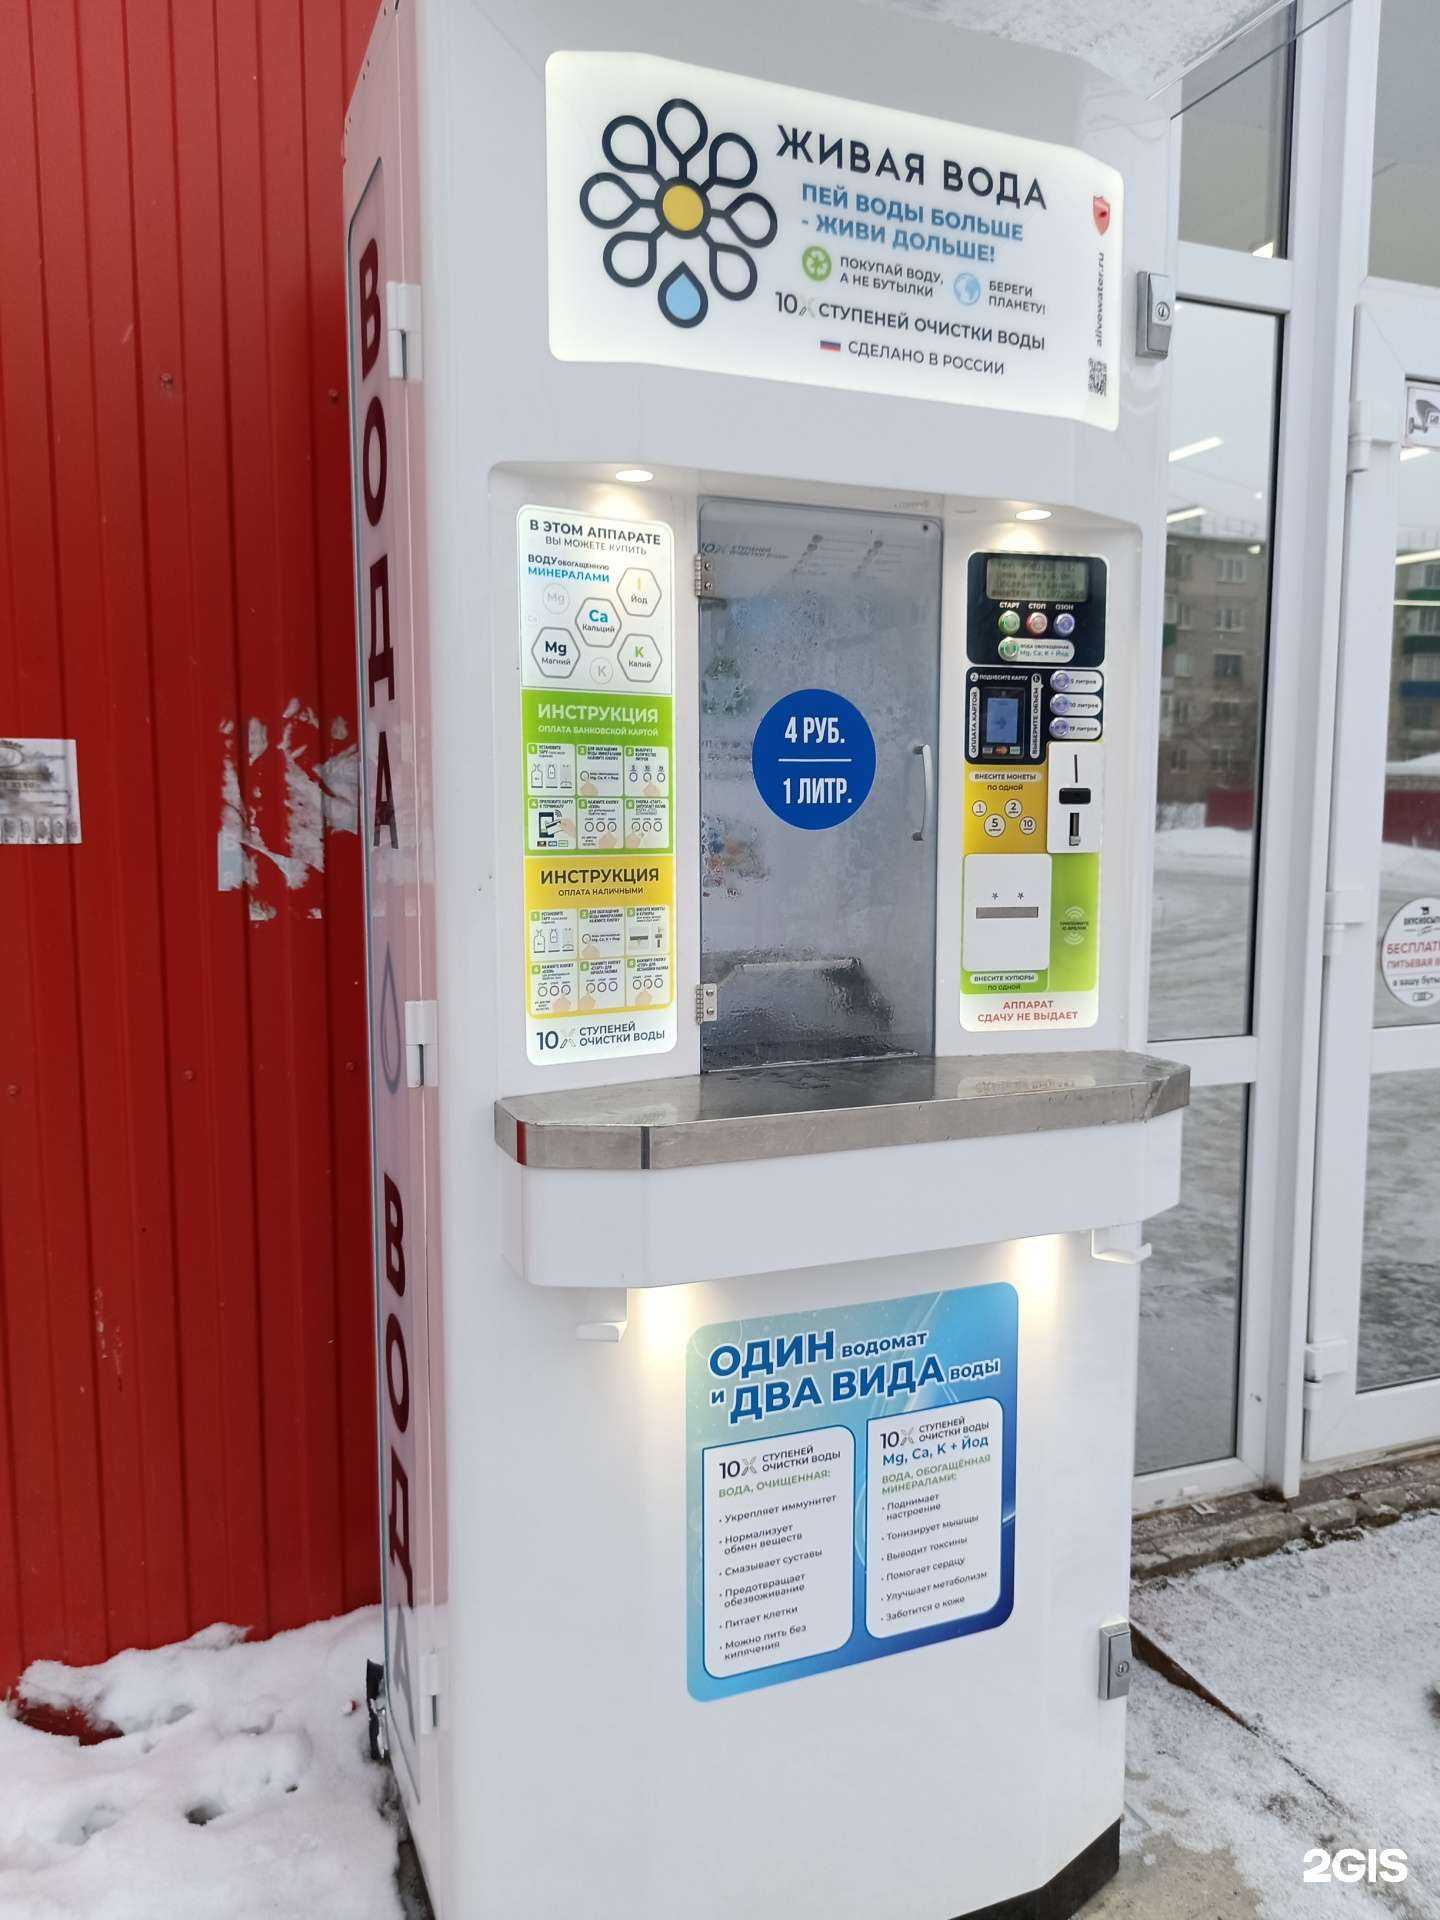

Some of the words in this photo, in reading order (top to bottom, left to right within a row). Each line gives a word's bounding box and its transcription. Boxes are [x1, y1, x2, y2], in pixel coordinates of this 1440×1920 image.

[776, 125, 925, 185] ЖИВАЯ
[944, 159, 1047, 210] ВОДА
[802, 182, 848, 209] ПЕЙ
[856, 193, 924, 223] ВОДЫ
[931, 207, 1023, 241] БОЛЬШЕ
[816, 214, 886, 243] ЖИВИ
[892, 229, 995, 262] ДОЛЬШЕ!
[840, 257, 903, 278] ПОКУПАЙ
[906, 269, 944, 285] ВОДУ,
[840, 272, 849, 283] А
[852, 275, 870, 288] НЕ
[873, 278, 934, 298] БУТЫЛКИ
[989, 280, 1033, 297] БЕРЕГИ
[988, 296, 1046, 315] ПЛАНЕТУ!
[818, 303, 909, 330] СТУПЕНЕЙ
[914, 318, 993, 342] ОЧИСТКИ
[997, 330, 1045, 351] ВОДЫ
[848, 340, 925, 364] СДЕЛАНО
[929, 353, 938, 366] В
[943, 354, 1005, 376] РОССИИ
[530, 519, 538, 531] В
[543, 521, 583, 536] ЭТОМ
[588, 527, 661, 545] АППАРАТЕ
[358, 238, 399, 850] ВОДА
[545, 535, 561, 545] ВЫ
[564, 538, 605, 550] МОЖЕТЕ
[609, 543, 647, 555] КУПИТЬ
[528, 554, 557, 565] ВОДУ
[528, 566, 610, 582] МИНЕРАЛАМИ
[631, 594, 648, 605] Йод
[589, 609, 608, 623] Ca
[582, 624, 615, 633] Кальций
[545, 641, 567, 656] Mg
[635, 646, 644, 658] K
[541, 657, 571, 666] Магний
[628, 660, 651, 669] Калий
[538, 704, 659, 724] ИНСТРУКЦИЯ
[538, 725, 572, 734] ОПЛАТА
[573, 726, 626, 735] БАНКОВСКОЙ
[629, 728, 659, 737] КАРТОЙ
[784, 716, 797, 744] 4
[803, 716, 846, 744] РУБ.
[783, 778, 791, 804] 1
[797, 777, 852, 805] ЛИТР.
[1011, 802, 1017, 810] 2
[992, 818, 998, 827] 5
[540, 868, 659, 886] ИНСТРУКЦИЯ
[558, 889, 591, 897] ОПЛАТА
[593, 887, 644, 895] НАЛИЧНЫМИ
[1003, 1000, 1053, 1009] АППАРАТ
[977, 1013, 1013, 1023] СДАЧУ
[1016, 1013, 1032, 1021] НЕ
[1034, 1012, 1078, 1020] ВЫДАЕТ
[579, 1021, 636, 1036] СТУПЕНЕЙ
[579, 1032, 632, 1046] ОЧИСТКИ
[634, 1030, 665, 1041] ВОДЫ
[709, 1330, 835, 1379] ОДИН
[841, 1331, 927, 1359] водомат
[711, 1390, 725, 1404] и
[729, 1376, 822, 1424] ДВА
[832, 1354, 944, 1402] ВИДА
[950, 1359, 999, 1381] воды
[919, 1416, 966, 1433] СТУПЕНЕЙ
[919, 1427, 961, 1443] ОЧИСТКИ
[962, 1422, 990, 1434] ВОДЫ
[762, 1445, 814, 1463] СТУПЕНЕЙ
[762, 1455, 809, 1472] ОЧИСТКИ
[811, 1451, 841, 1464] ВОДЫ
[882, 1453, 908, 1467] Mg,
[912, 1447, 933, 1460] Ca,
[937, 1443, 946, 1454] K
[951, 1442, 957, 1451] +
[961, 1435, 989, 1450] Йод
[718, 1483, 754, 1498] ВОДА,
[756, 1469, 831, 1491] ОЧИЩЕННАЯ:
[882, 1470, 913, 1484] ВОДА,
[724, 1505, 780, 1524] Укрепляет
[781, 1494, 837, 1513] иммунитет
[886, 1503, 941, 1521] настроение
[887, 1493, 939, 1511] Поднимает
[725, 1523, 793, 1544] Нормализует
[887, 1522, 940, 1541] Тонизирует
[942, 1514, 979, 1531] мышцы
[724, 1541, 757, 1555] обмен
[759, 1532, 802, 1549] веществ
[886, 1545, 928, 1562] Выводит
[929, 1536, 968, 1553] токсины
[724, 1557, 781, 1577] Смазывает
[782, 1548, 823, 1565] суставы
[886, 1564, 931, 1581] Помогает
[932, 1557, 965, 1572] сердцу
[724, 1583, 805, 1608] обезвоживание
[725, 1572, 806, 1599] Предотвращает
[886, 1584, 931, 1602] Улучшает
[933, 1570, 987, 1590] метаболизм
[725, 1614, 761, 1629] Питает
[763, 1605, 798, 1621] клетки
[886, 1605, 932, 1622] Заботится
[934, 1602, 940, 1610] о
[942, 1595, 965, 1608] коже
[725, 1634, 761, 1650] Можно
[763, 1628, 787, 1641] пить
[789, 1623, 806, 1635] без
[724, 1640, 780, 1660] кипячения
